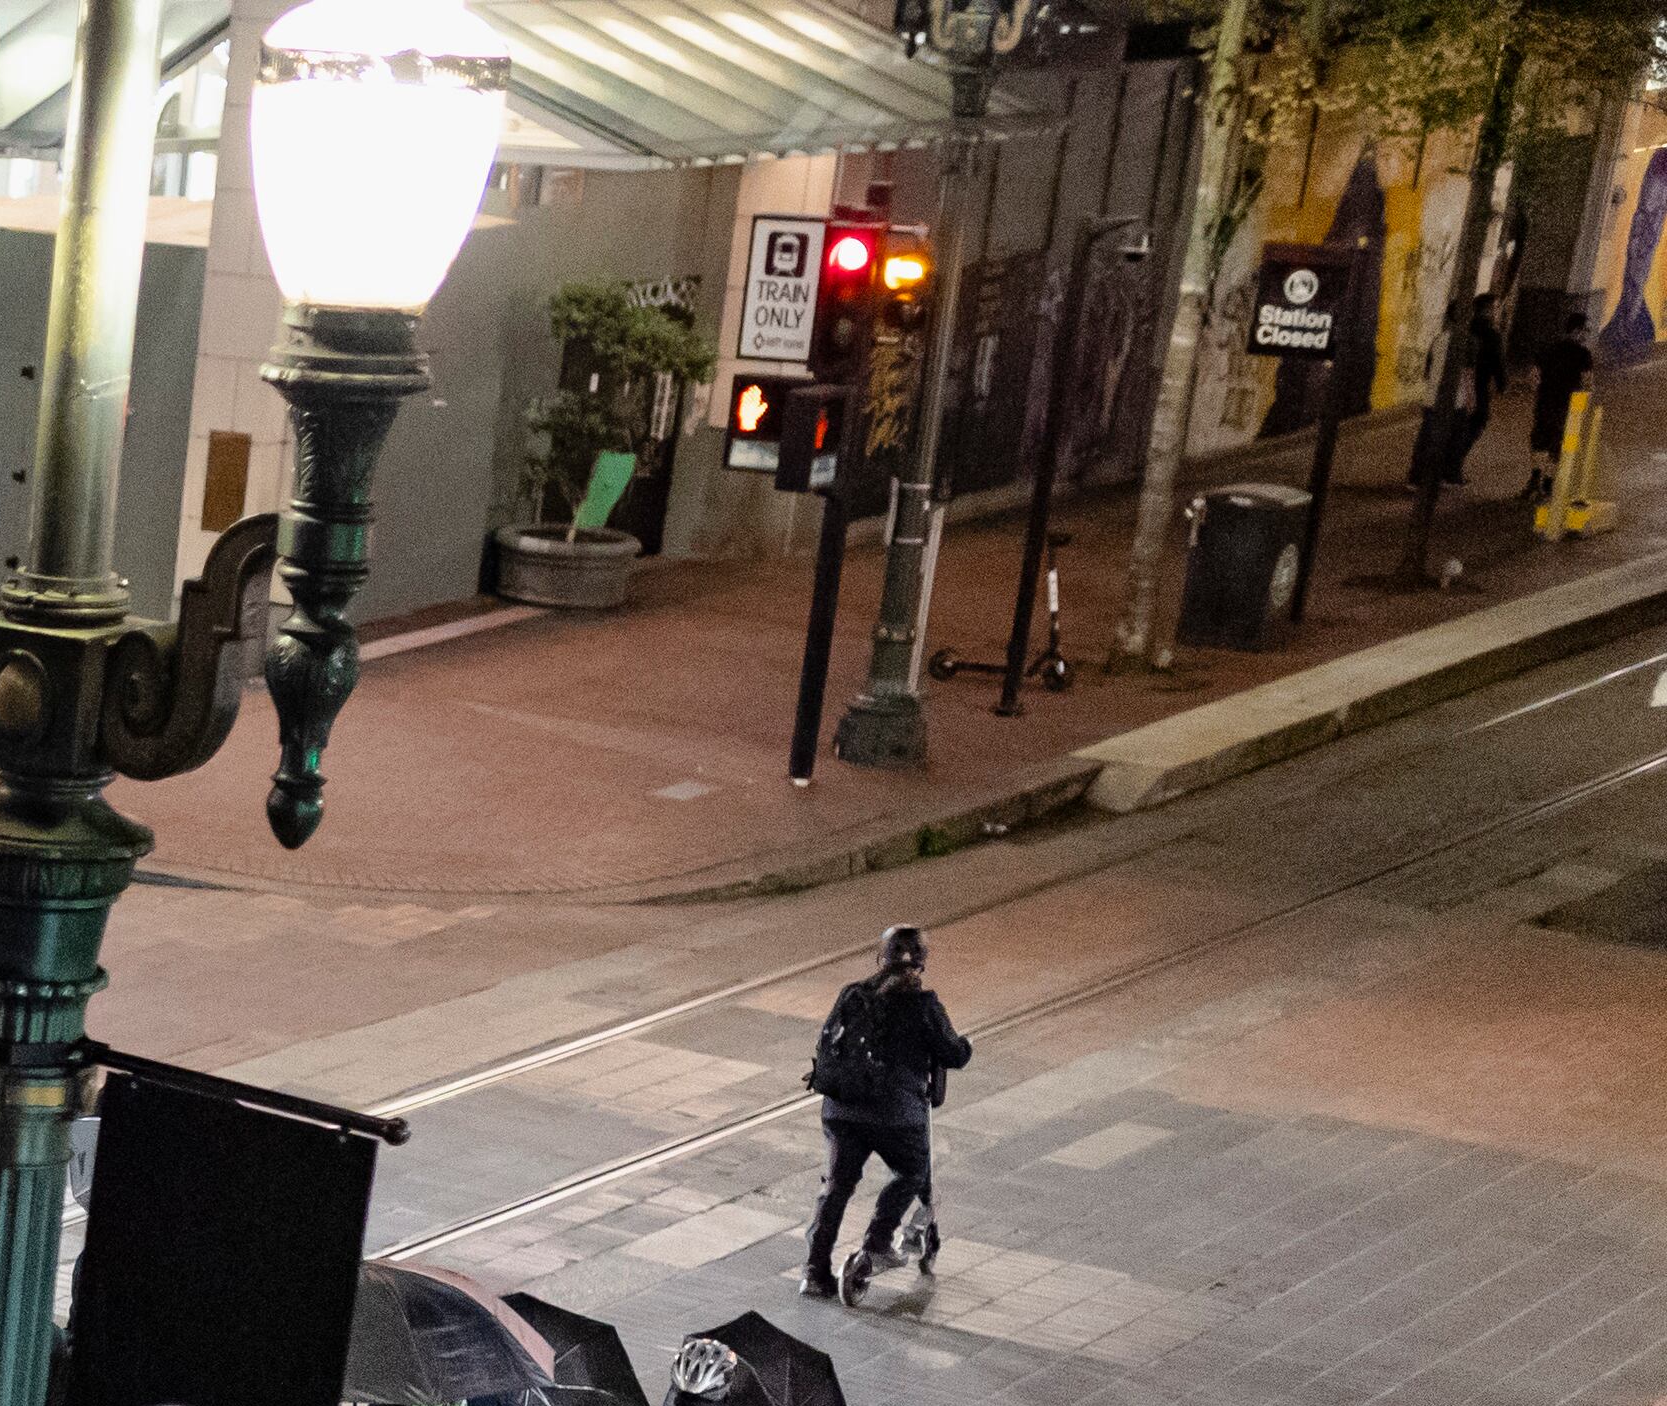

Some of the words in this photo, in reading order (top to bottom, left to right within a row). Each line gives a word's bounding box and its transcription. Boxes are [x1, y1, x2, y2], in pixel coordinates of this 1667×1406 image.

[755, 280, 810, 304] TRAIN
[755, 305, 805, 329] ONLY
[1259, 304, 1332, 329] Station
[1256, 324, 1329, 350] Closed
